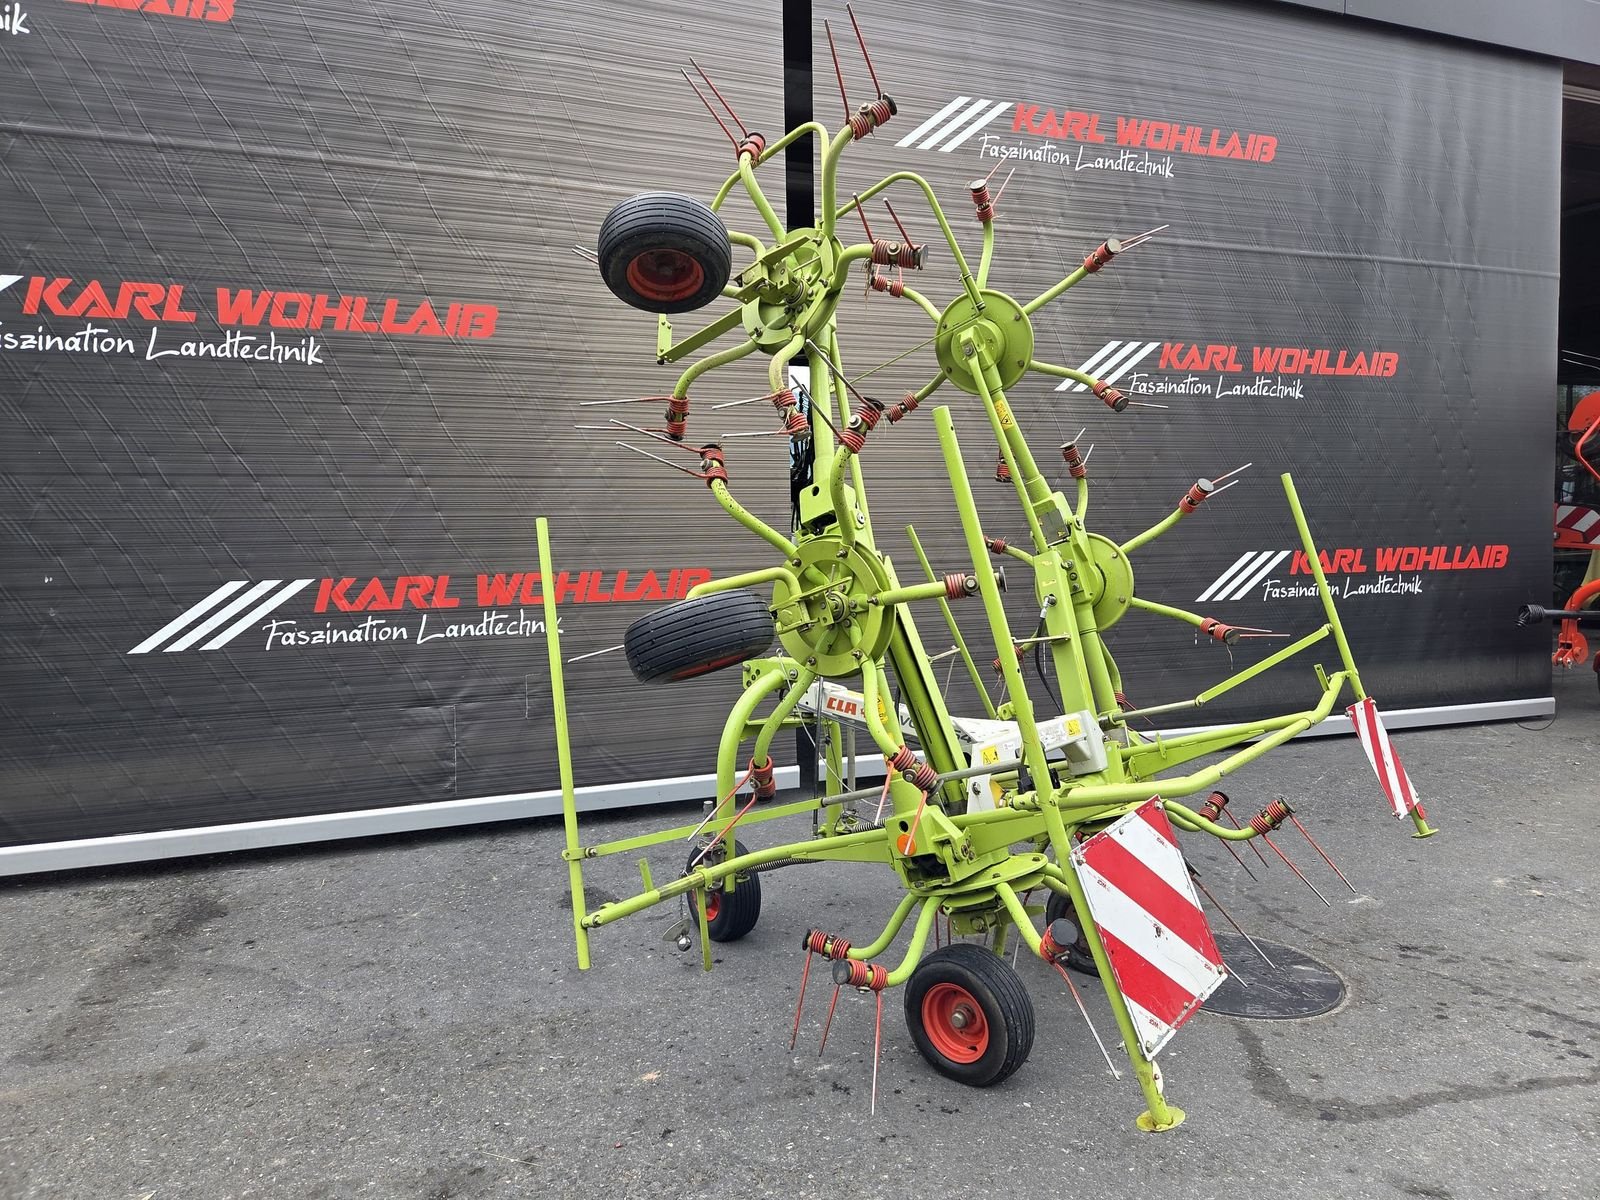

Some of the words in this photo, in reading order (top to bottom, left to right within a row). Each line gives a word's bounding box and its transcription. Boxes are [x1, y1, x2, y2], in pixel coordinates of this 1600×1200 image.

[1012, 103, 1105, 142] KARL
[1116, 116, 1278, 163] WOHLLAIB
[978, 133, 1070, 166] Faszination
[1074, 145, 1175, 178] Landtechnik
[22, 276, 197, 323] KARL
[216, 287, 499, 339] WOHLLAIB
[146, 326, 323, 365] Landtechnik
[1158, 342, 1243, 373] KARL
[1253, 346, 1399, 377] WOHLLAIB
[1128, 371, 1211, 396] Faszination
[1215, 375, 1304, 400] Landtechnik
[1290, 548, 1367, 575] KARL
[1375, 544, 1509, 572] WOHLLAIB
[313, 575, 461, 613] KARL
[1343, 573, 1423, 600] Landtechnik
[262, 615, 409, 651] Faszination
[416, 607, 564, 645] Landtechn
